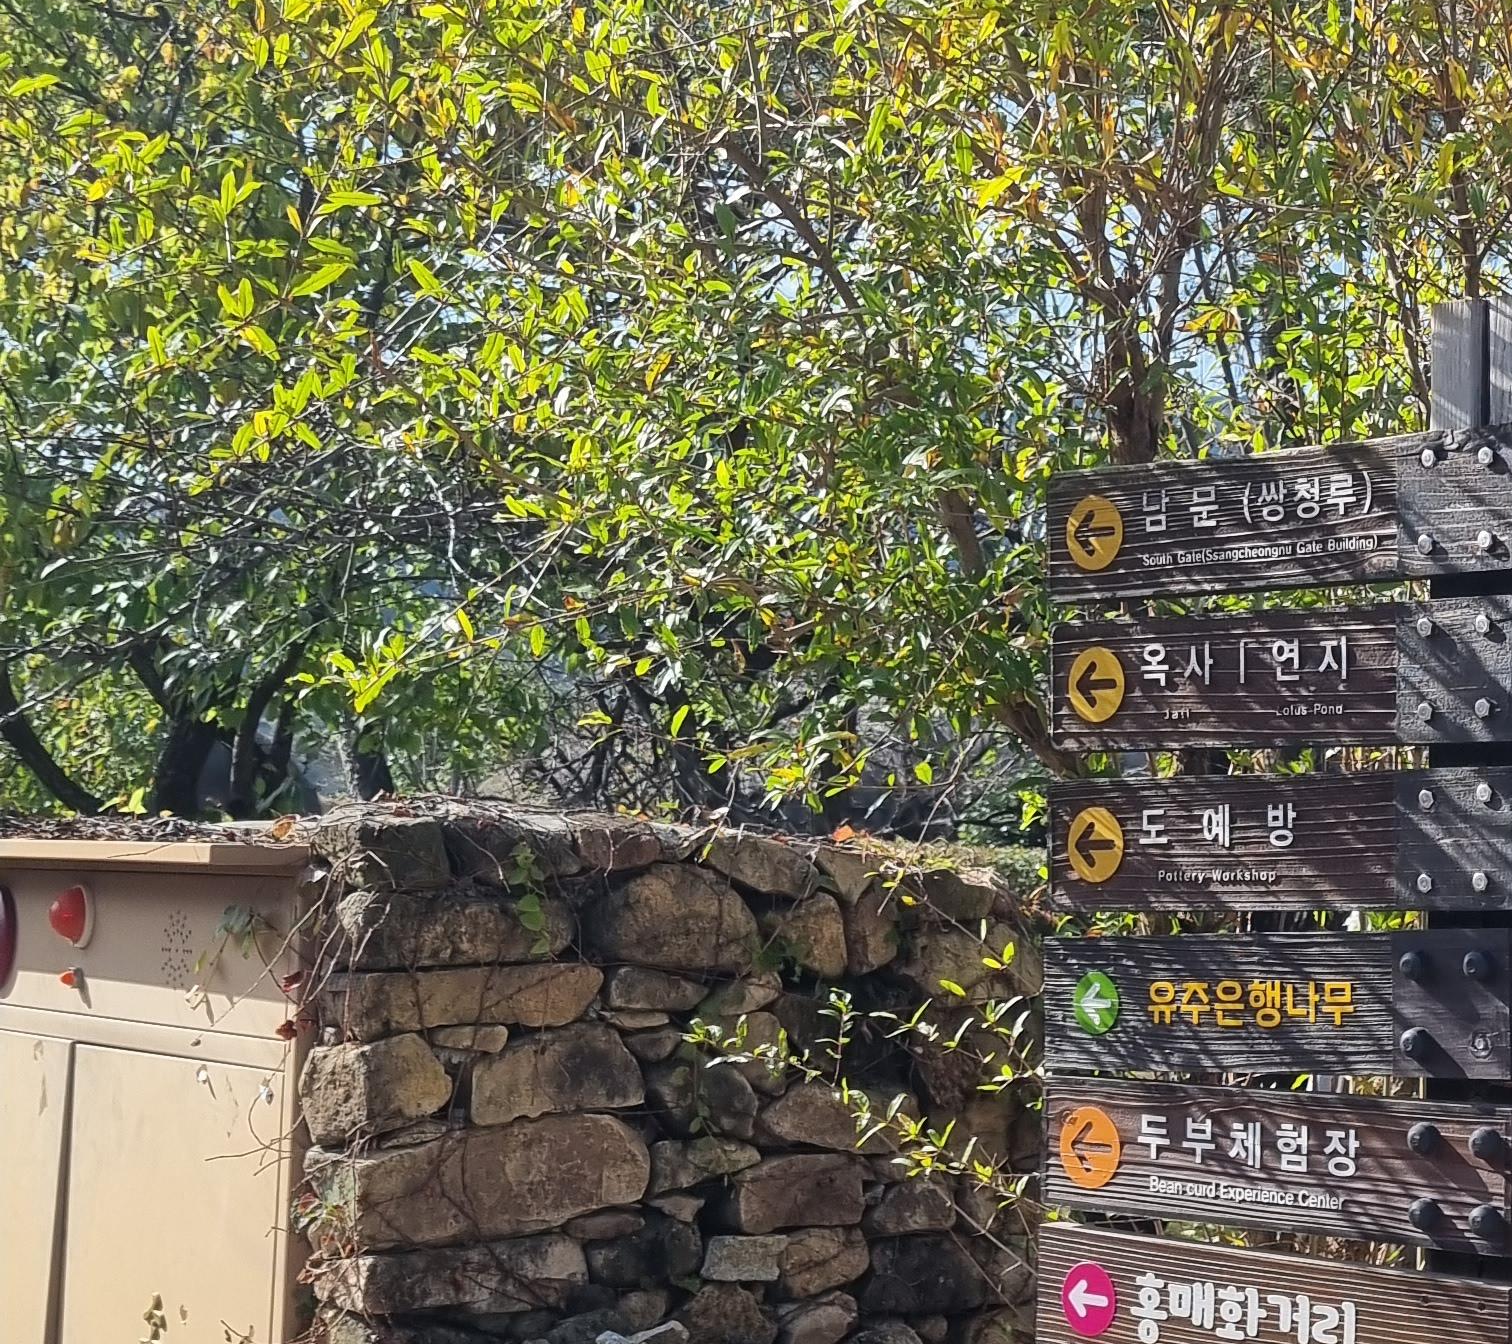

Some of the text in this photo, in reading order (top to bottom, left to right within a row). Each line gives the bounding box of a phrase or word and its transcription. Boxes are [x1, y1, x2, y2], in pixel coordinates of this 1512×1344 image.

[1142, 552, 1173, 567] South
[1296, 541, 1323, 554] Gate
[1327, 534, 1378, 552] Building)
[1163, 708, 1191, 720] Jail
[1313, 703, 1343, 715] Pond
[1158, 868, 1277, 884] Pottery Workshop
[1147, 979, 1355, 1029] 유주은행나무
[1137, 1114, 1361, 1177] 두부체험장
[1219, 1183, 1294, 1205] Experience
[1298, 1189, 1346, 1211] Center
